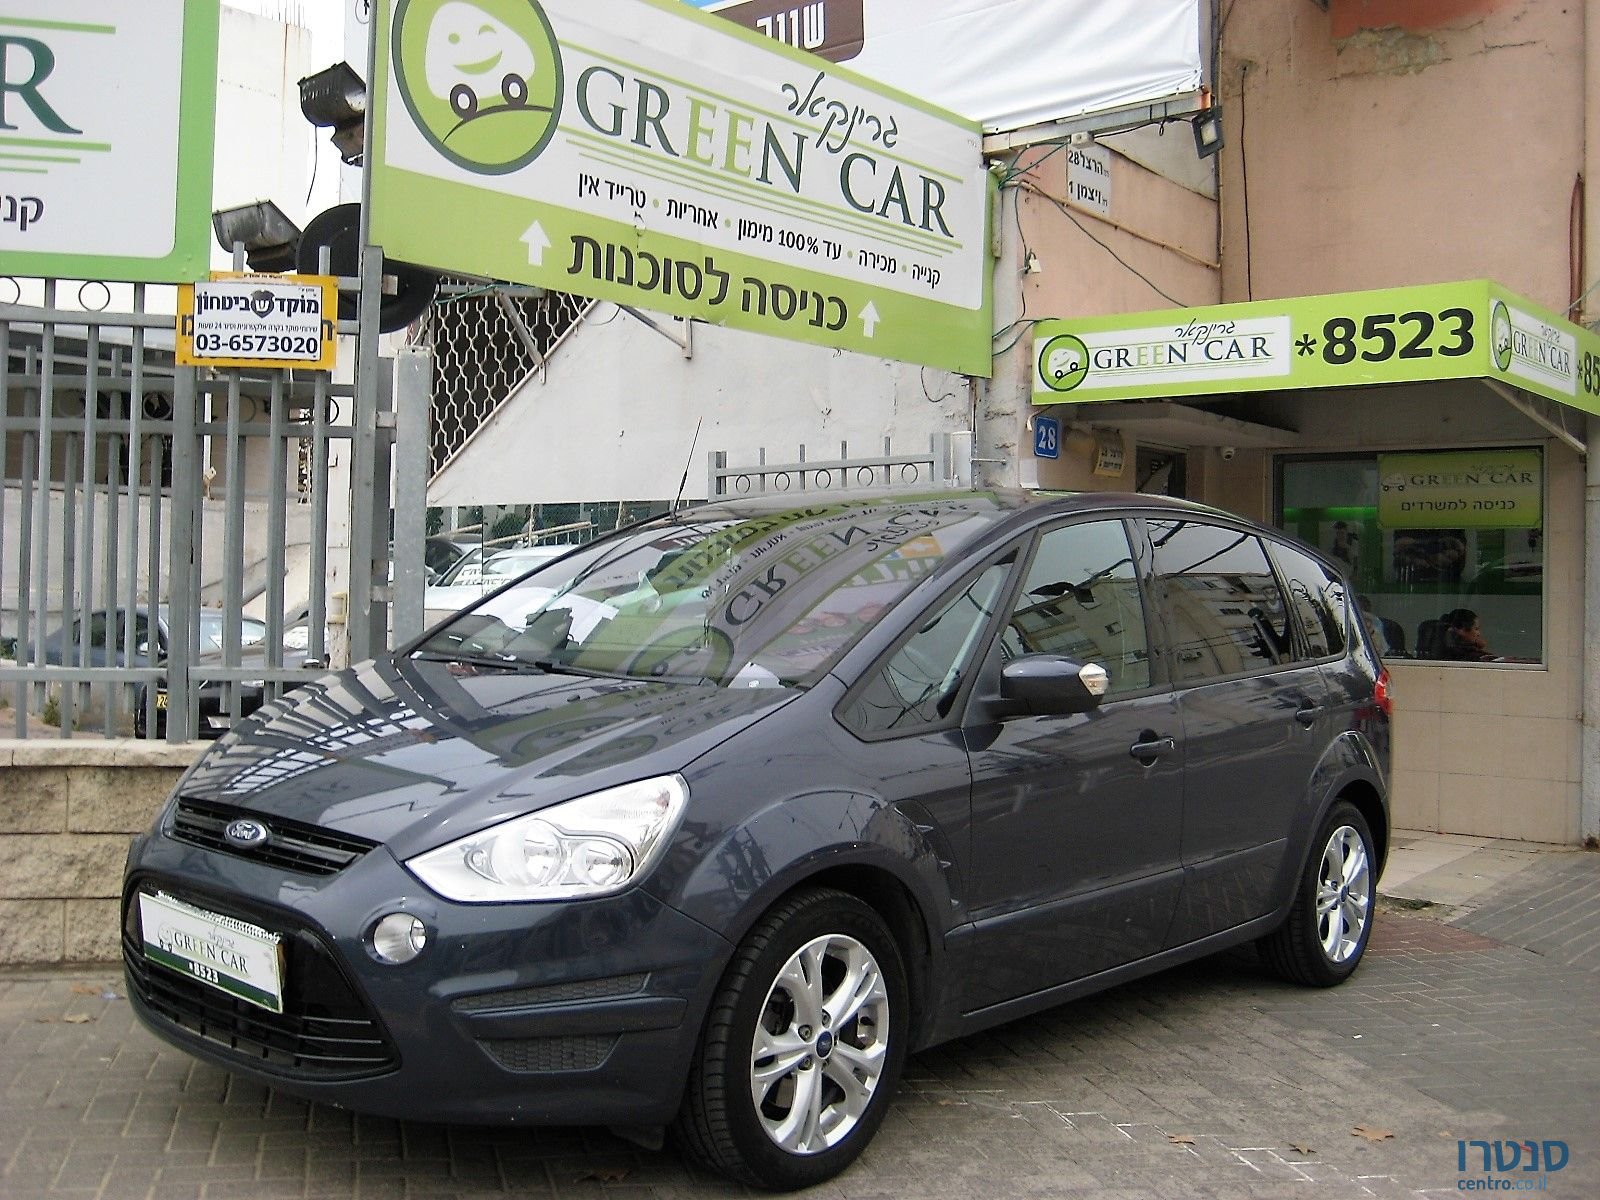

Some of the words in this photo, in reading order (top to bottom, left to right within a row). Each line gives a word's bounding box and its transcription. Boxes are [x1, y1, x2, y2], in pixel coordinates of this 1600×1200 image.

[575, 65, 809, 194] GREEN
[839, 152, 955, 238] CAR
[577, 172, 600, 198] אין
[604, 180, 647, 209] טרייד
[0, 194, 45, 232] קנ
[665, 198, 719, 230] אחריות
[737, 218, 773, 242] מימון
[778, 229, 819, 255] 100%
[822, 239, 842, 260] עד
[858, 249, 897, 275] מכירה
[566, 234, 730, 306] לסוכנות
[912, 263, 941, 290] קנייה
[741, 276, 848, 332] כניסה
[195, 333, 319, 354] 03-6573020
[1093, 342, 1189, 370] GREEN
[1204, 336, 1272, 362] CAR
[1513, 330, 1546, 365] GREEN
[1550, 346, 1571, 375] CAR
[1038, 424, 1056, 450] 28
[1410, 473, 1481, 487] GREEN
[1490, 472, 1535, 484] CAR
[1401, 498, 1467, 512] למשרדים
[1472, 499, 1516, 511] כניסה
[174, 931, 217, 961] GREEN
[220, 949, 248, 974] CAR
